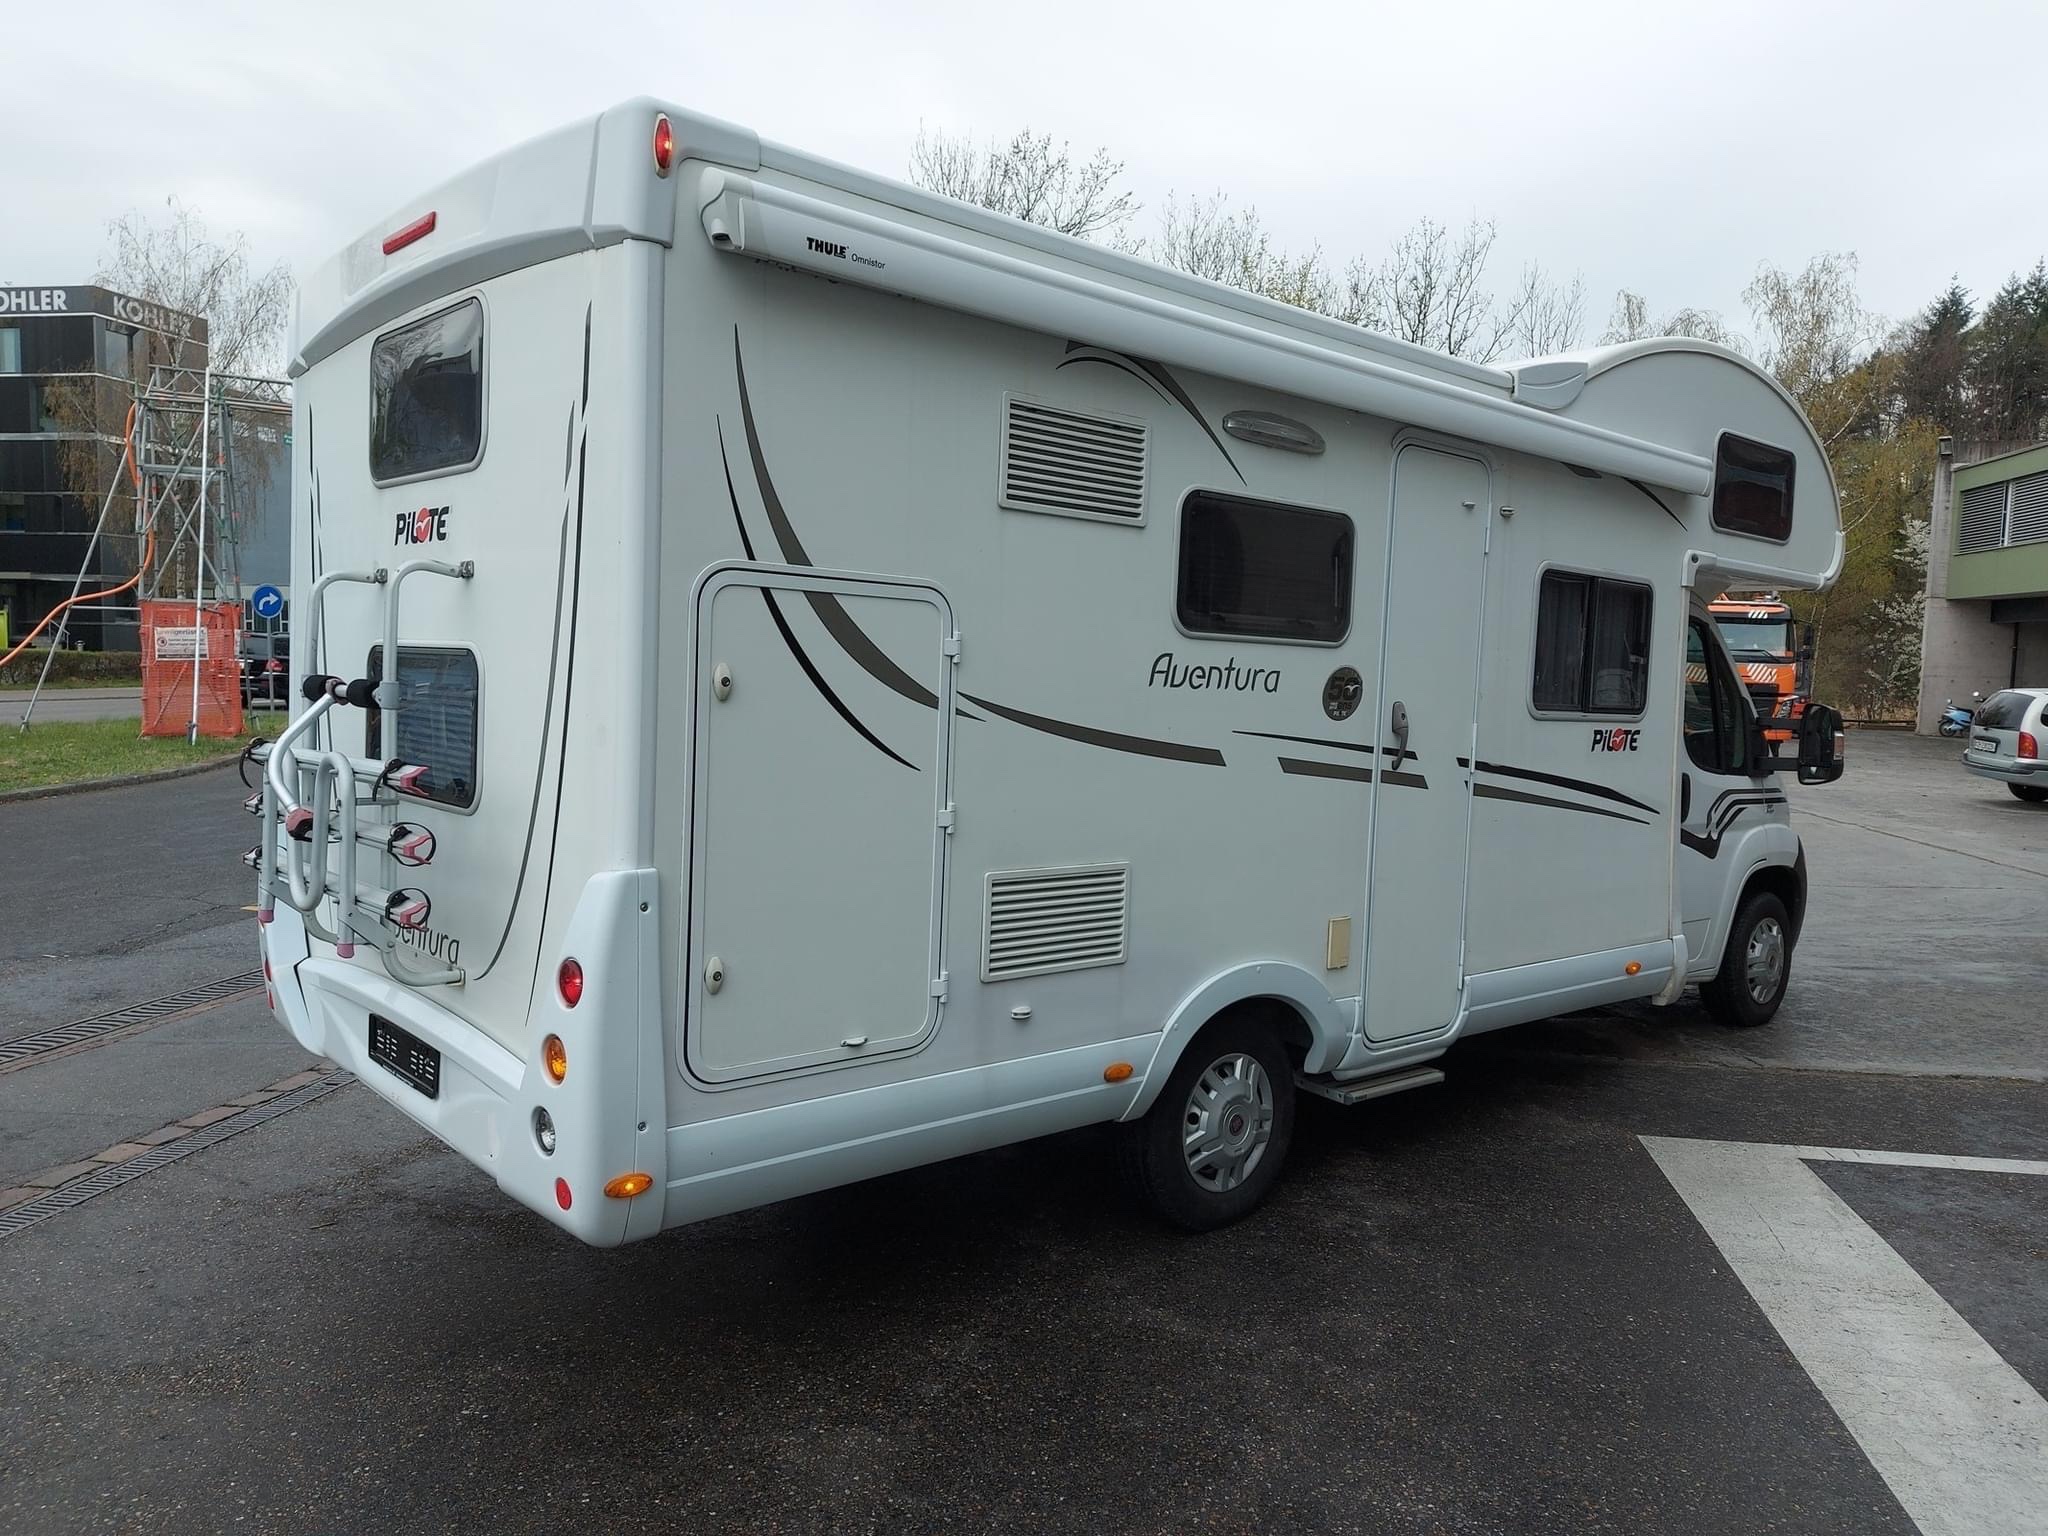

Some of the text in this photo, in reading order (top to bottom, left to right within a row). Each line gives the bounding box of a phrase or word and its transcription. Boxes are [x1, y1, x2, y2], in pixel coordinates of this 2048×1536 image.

[806, 236, 886, 270] THULE Omnistor
[1148, 653, 1281, 693] Aventura
